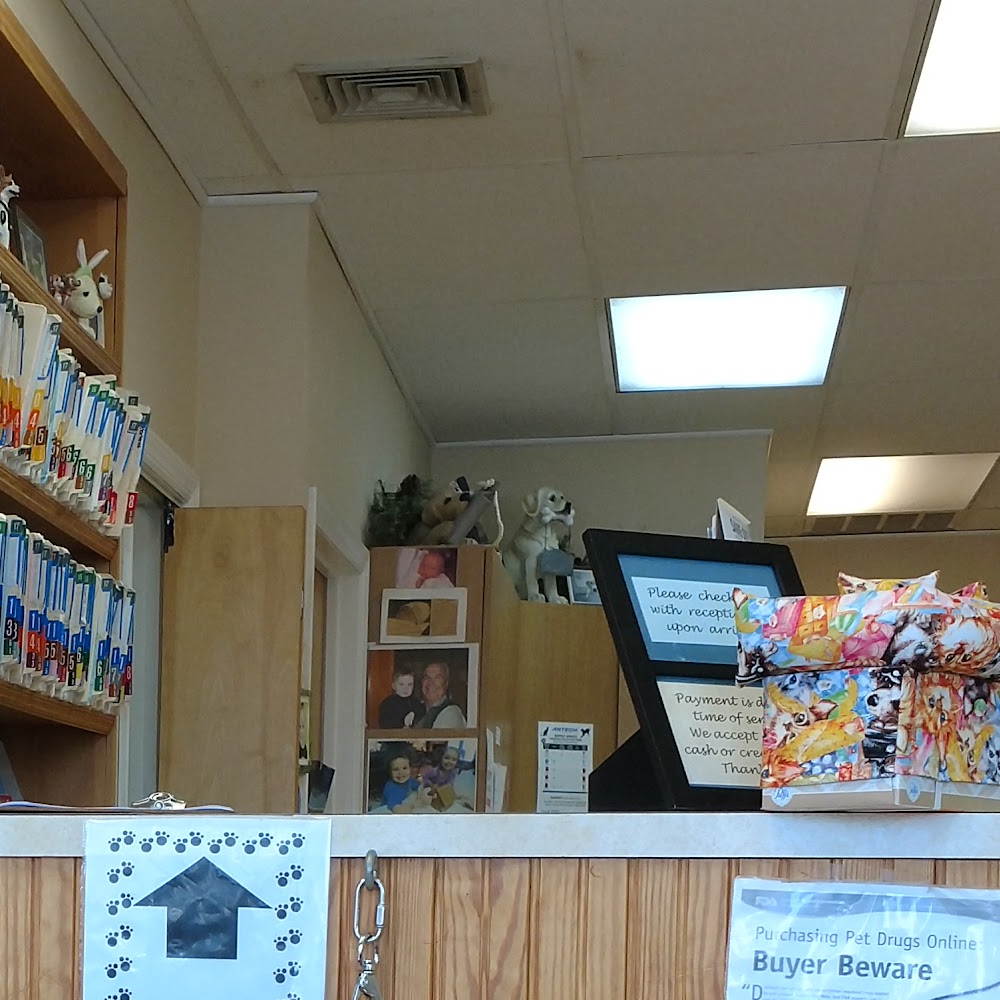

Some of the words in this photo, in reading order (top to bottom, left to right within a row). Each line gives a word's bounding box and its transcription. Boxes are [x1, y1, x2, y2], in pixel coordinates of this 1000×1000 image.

[647, 587, 692, 600] Please
[698, 590, 734, 602] check
[650, 604, 682, 616] with
[689, 608, 736, 620] recepti
[666, 623, 703, 635] upon
[709, 623, 737, 634] arri
[675, 692, 738, 707] Payment
[740, 696, 752, 707] is
[693, 711, 728, 722] time
[730, 711, 743, 723] of
[690, 727, 714, 738] We
[715, 730, 758, 742] accept
[685, 744, 720, 756] cash
[720, 747, 736, 756] or
[755, 926, 838, 947] Purchasing
[846, 930, 871, 945] Pet
[878, 931, 920, 951] Drugs
[927, 934, 977, 950] Online
[753, 950, 827, 979] Buyer
[838, 954, 933, 980] Beware
